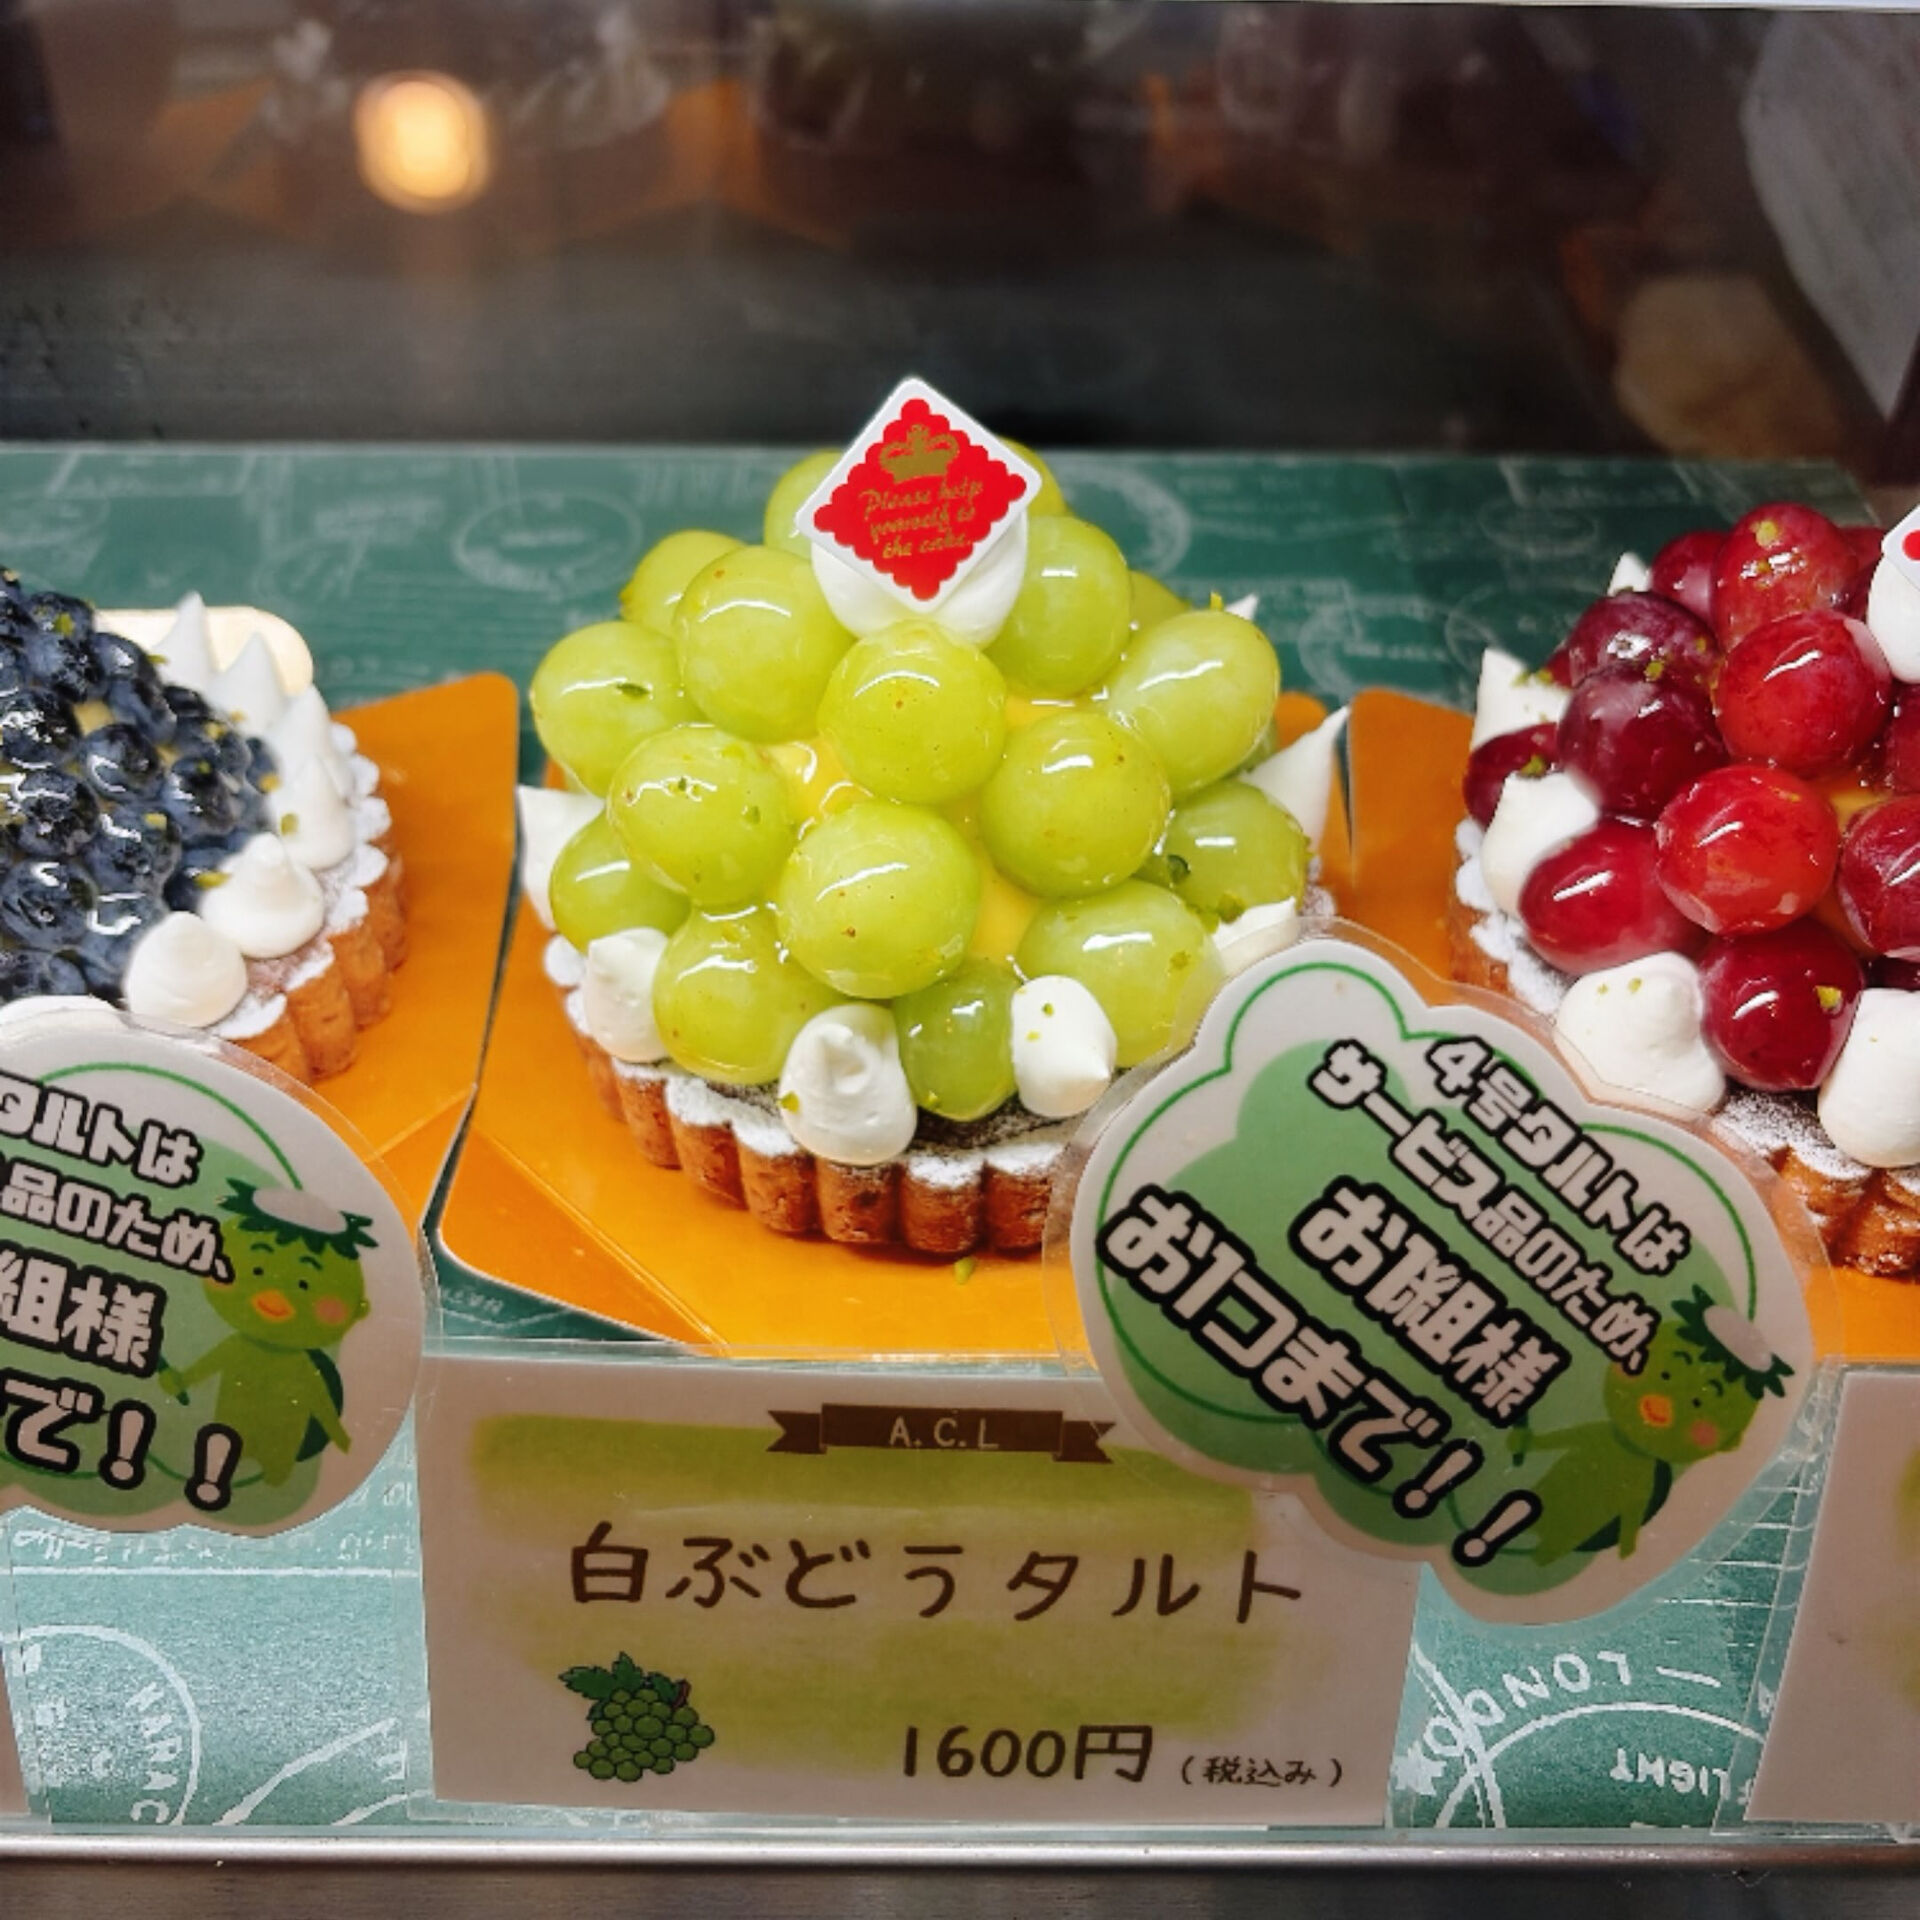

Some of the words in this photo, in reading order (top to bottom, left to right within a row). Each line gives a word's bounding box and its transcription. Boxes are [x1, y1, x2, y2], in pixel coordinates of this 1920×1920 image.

[858, 489, 932, 521] Please
[882, 535, 913, 558] the
[1427, 1037, 1690, 1275] 4号タルトは
[1308, 1039, 1661, 1374] サービス品のため、
[571, 1521, 1302, 1624] 白ぶどうタルト
[903, 1725, 1153, 1783] 1600円
